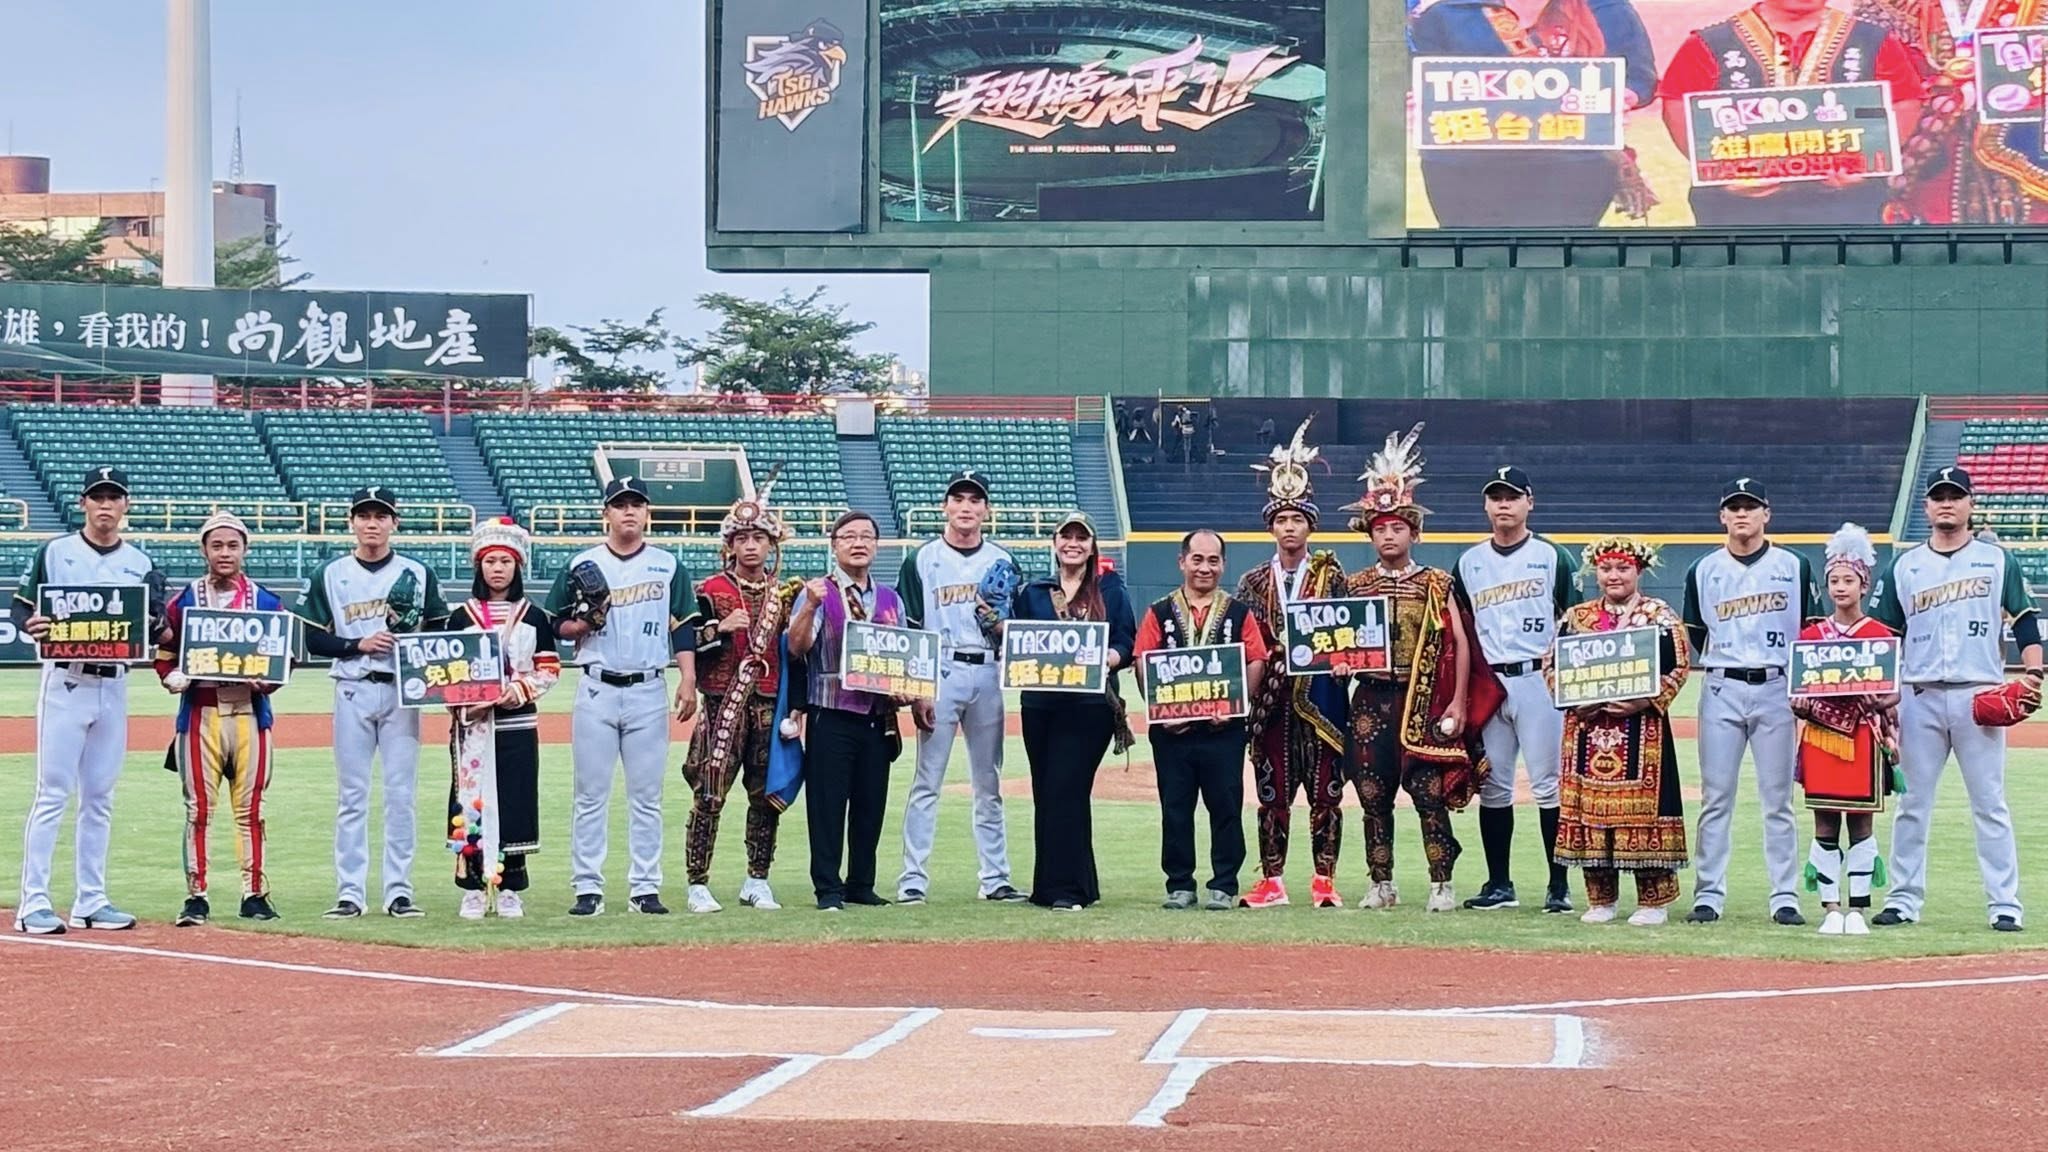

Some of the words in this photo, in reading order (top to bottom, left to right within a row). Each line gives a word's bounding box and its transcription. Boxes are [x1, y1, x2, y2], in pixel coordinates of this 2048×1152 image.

[770, 68, 813, 97] TSG
[1425, 68, 1569, 102] TAKAO
[758, 86, 832, 119] HAWKS
[1698, 96, 1808, 135] TAKAO
[1428, 107, 1585, 144] 挺台鋼
[1710, 128, 1865, 161] 雄鷹開打
[0, 307, 210, 349] 雄，看我的！
[228, 300, 485, 369] 尚觀地產
[45, 590, 103, 620] TAKAO
[1910, 577, 1992, 617] HAWKS
[50, 620, 132, 641] 雄鷹開打
[188, 616, 264, 643] TAKAO
[1288, 604, 1350, 635] TAKAO
[1522, 618, 1545, 634] 55
[1967, 621, 1989, 637] 95
[400, 638, 465, 668] TAKAO
[857, 626, 910, 656] TAKAO
[1009, 629, 1081, 654] TAKAO
[1311, 627, 1357, 654] 免費
[1562, 639, 1616, 667] TAKAO
[1766, 631, 1786, 648] 93
[187, 647, 271, 676] 挺台鋼
[1150, 654, 1204, 683] TAKAO
[1796, 645, 1856, 669] TAKAO
[424, 660, 471, 687] 免費
[1009, 659, 1087, 686] 挺台鋼
[1801, 666, 1883, 686] 免費入場
[1155, 680, 1231, 704] 雄鷹開打
